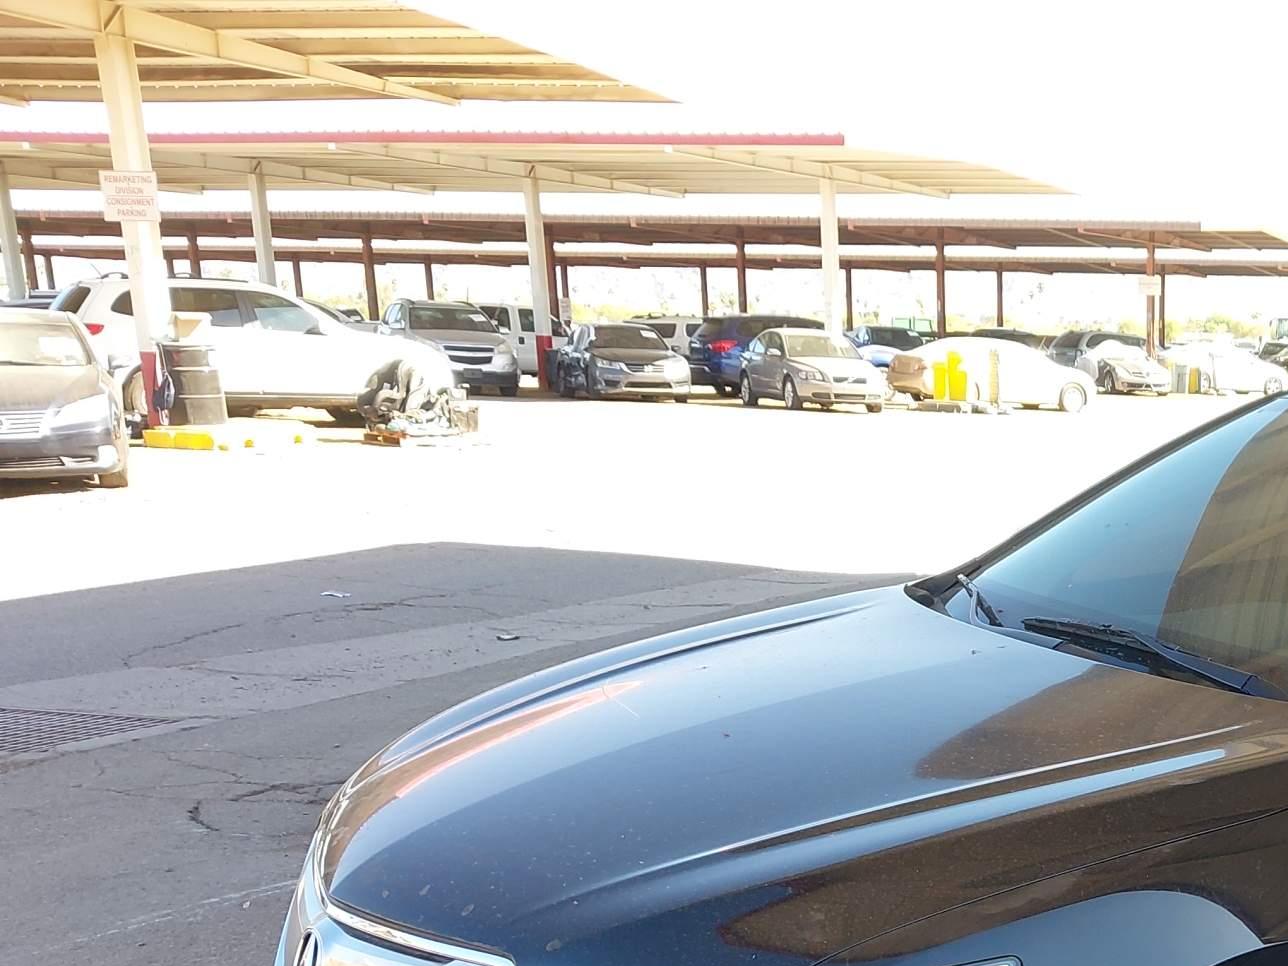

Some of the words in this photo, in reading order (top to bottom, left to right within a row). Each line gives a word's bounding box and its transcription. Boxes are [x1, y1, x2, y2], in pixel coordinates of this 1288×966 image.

[103, 175, 152, 184] REMARKETING
[115, 186, 144, 195] DIVISION
[105, 197, 155, 207] CONSIGNMENT
[117, 208, 147, 216] PARKING
